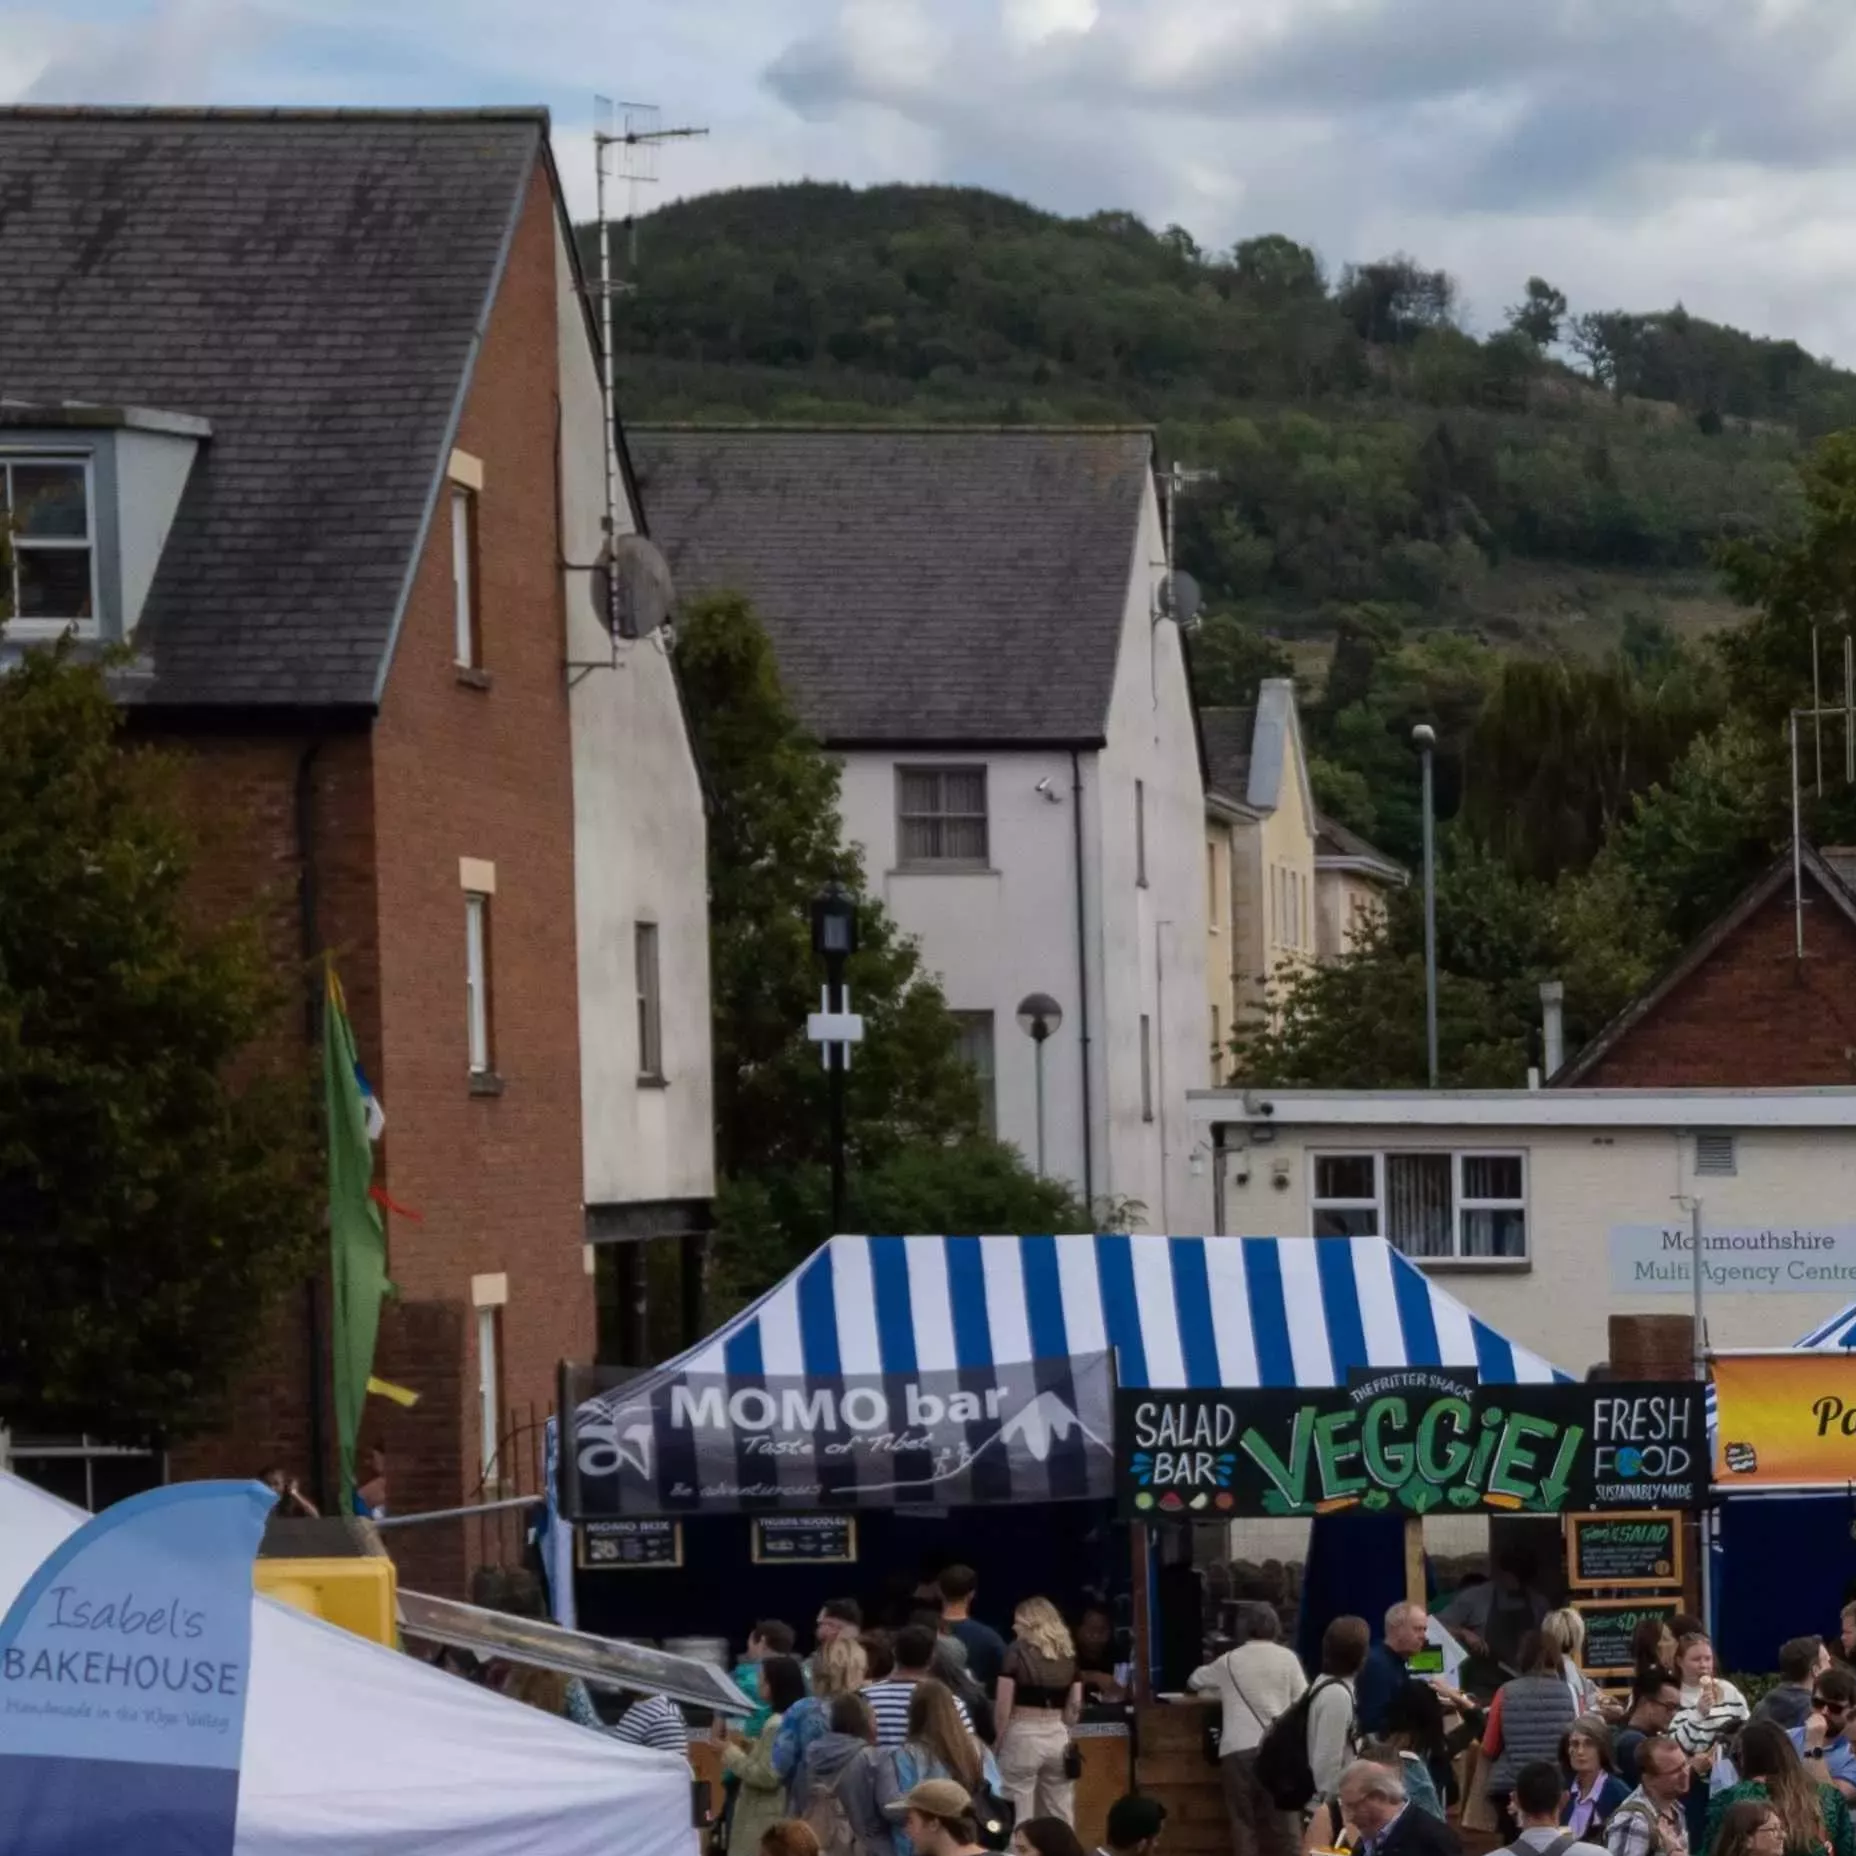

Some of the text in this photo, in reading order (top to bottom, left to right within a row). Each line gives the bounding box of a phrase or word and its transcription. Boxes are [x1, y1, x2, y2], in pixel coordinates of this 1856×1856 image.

[1662, 1230, 1836, 1251] Monmouthshire
[1634, 1261, 1690, 1281] Multi
[1702, 1260, 1780, 1285] Agency
[1372, 1371, 1428, 1394] FRITTER
[1429, 1373, 1475, 1403] SHACK
[671, 1383, 1009, 1432] MOMO bar
[1135, 1402, 1236, 1448] SALAD
[1594, 1397, 1690, 1442] FRESH
[742, 1434, 814, 1455] Taste
[1153, 1453, 1218, 1486] BAR
[47, 1585, 205, 1640] Isabel's
[2, 1648, 239, 1697] BAKEHOUSE
